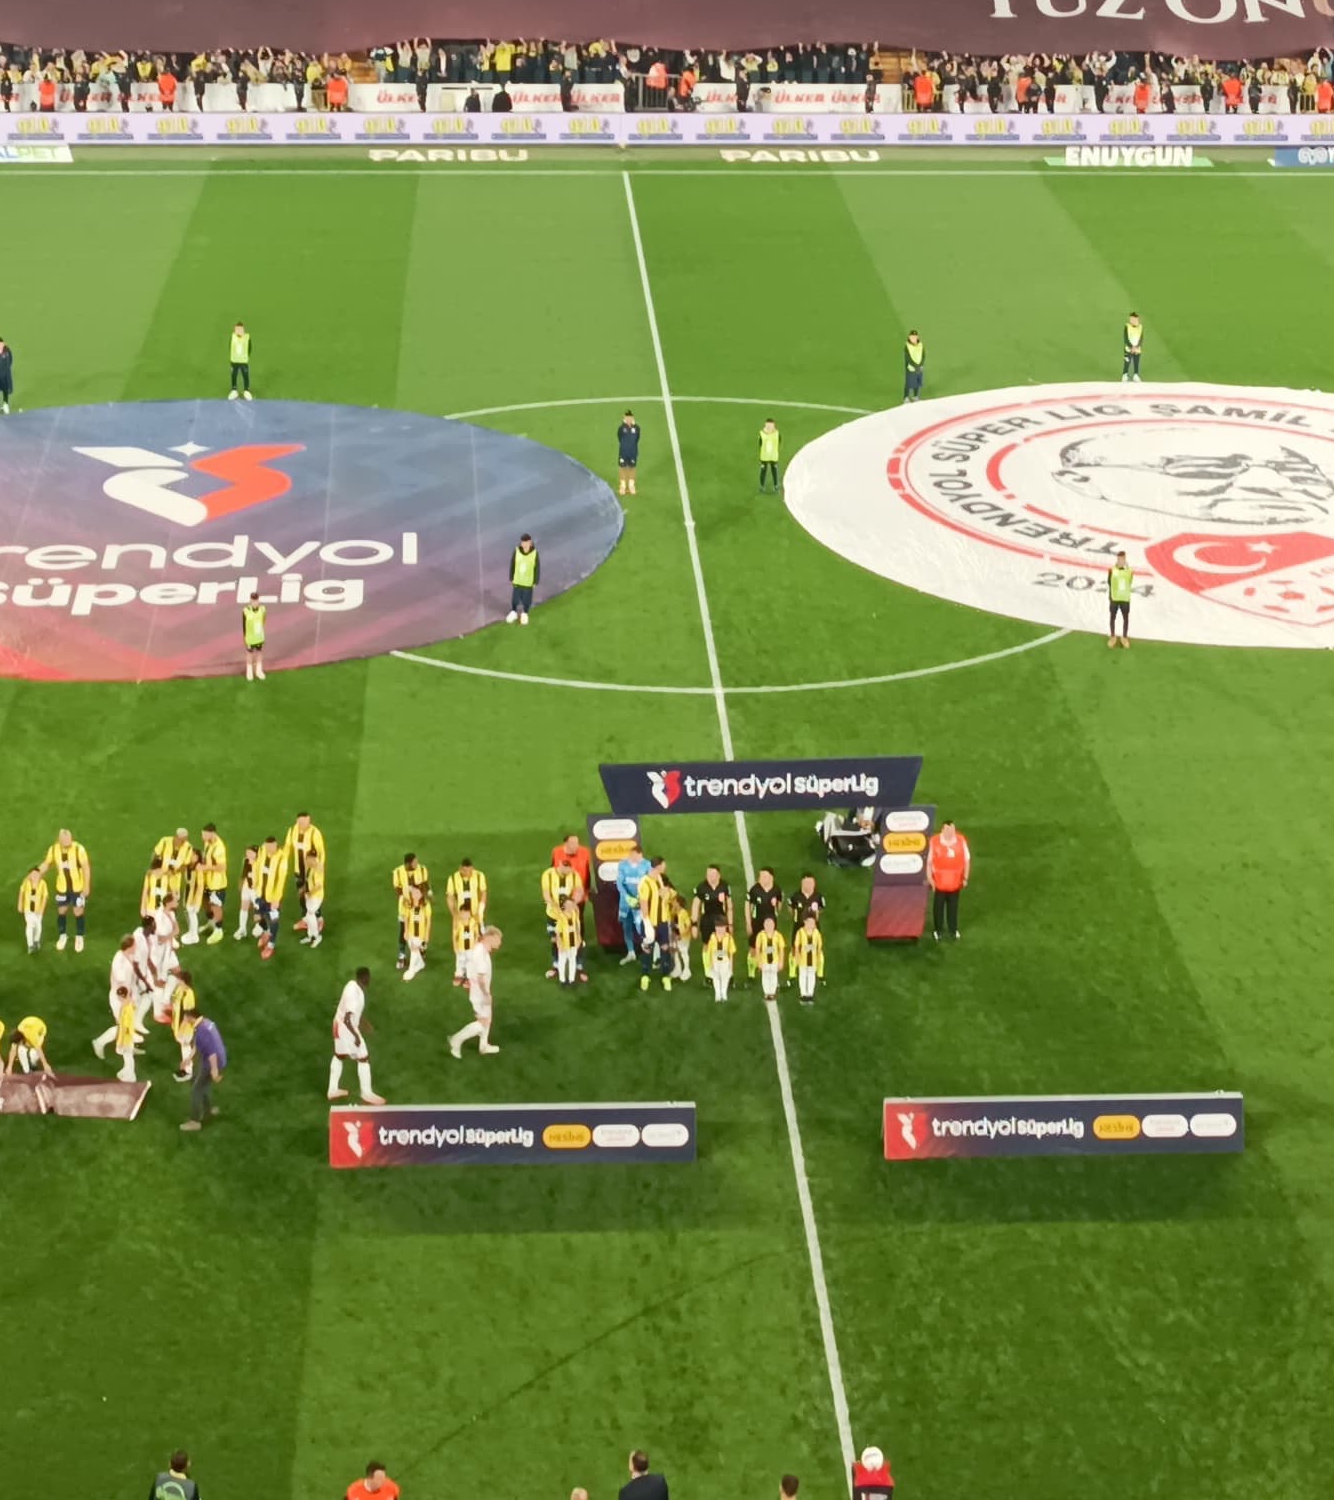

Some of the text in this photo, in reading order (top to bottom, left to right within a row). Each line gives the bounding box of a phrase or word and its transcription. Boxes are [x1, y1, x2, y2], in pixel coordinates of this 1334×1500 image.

[706, 91, 738, 103] ÜLK
[774, 92, 825, 104] ÜLKER
[368, 149, 528, 162] PARIBU
[720, 150, 880, 162] PARIBU
[1065, 146, 1194, 166] ENUYGUN
[1054, 403, 1132, 422] LİG
[931, 415, 1046, 463] SÜPER
[928, 464, 1121, 556] TRENDYOL
[1032, 571, 1156, 599] 204
[684, 772, 791, 800] trendyol
[378, 1124, 464, 1149] trendyol
[932, 1115, 1017, 1139] trendyol
